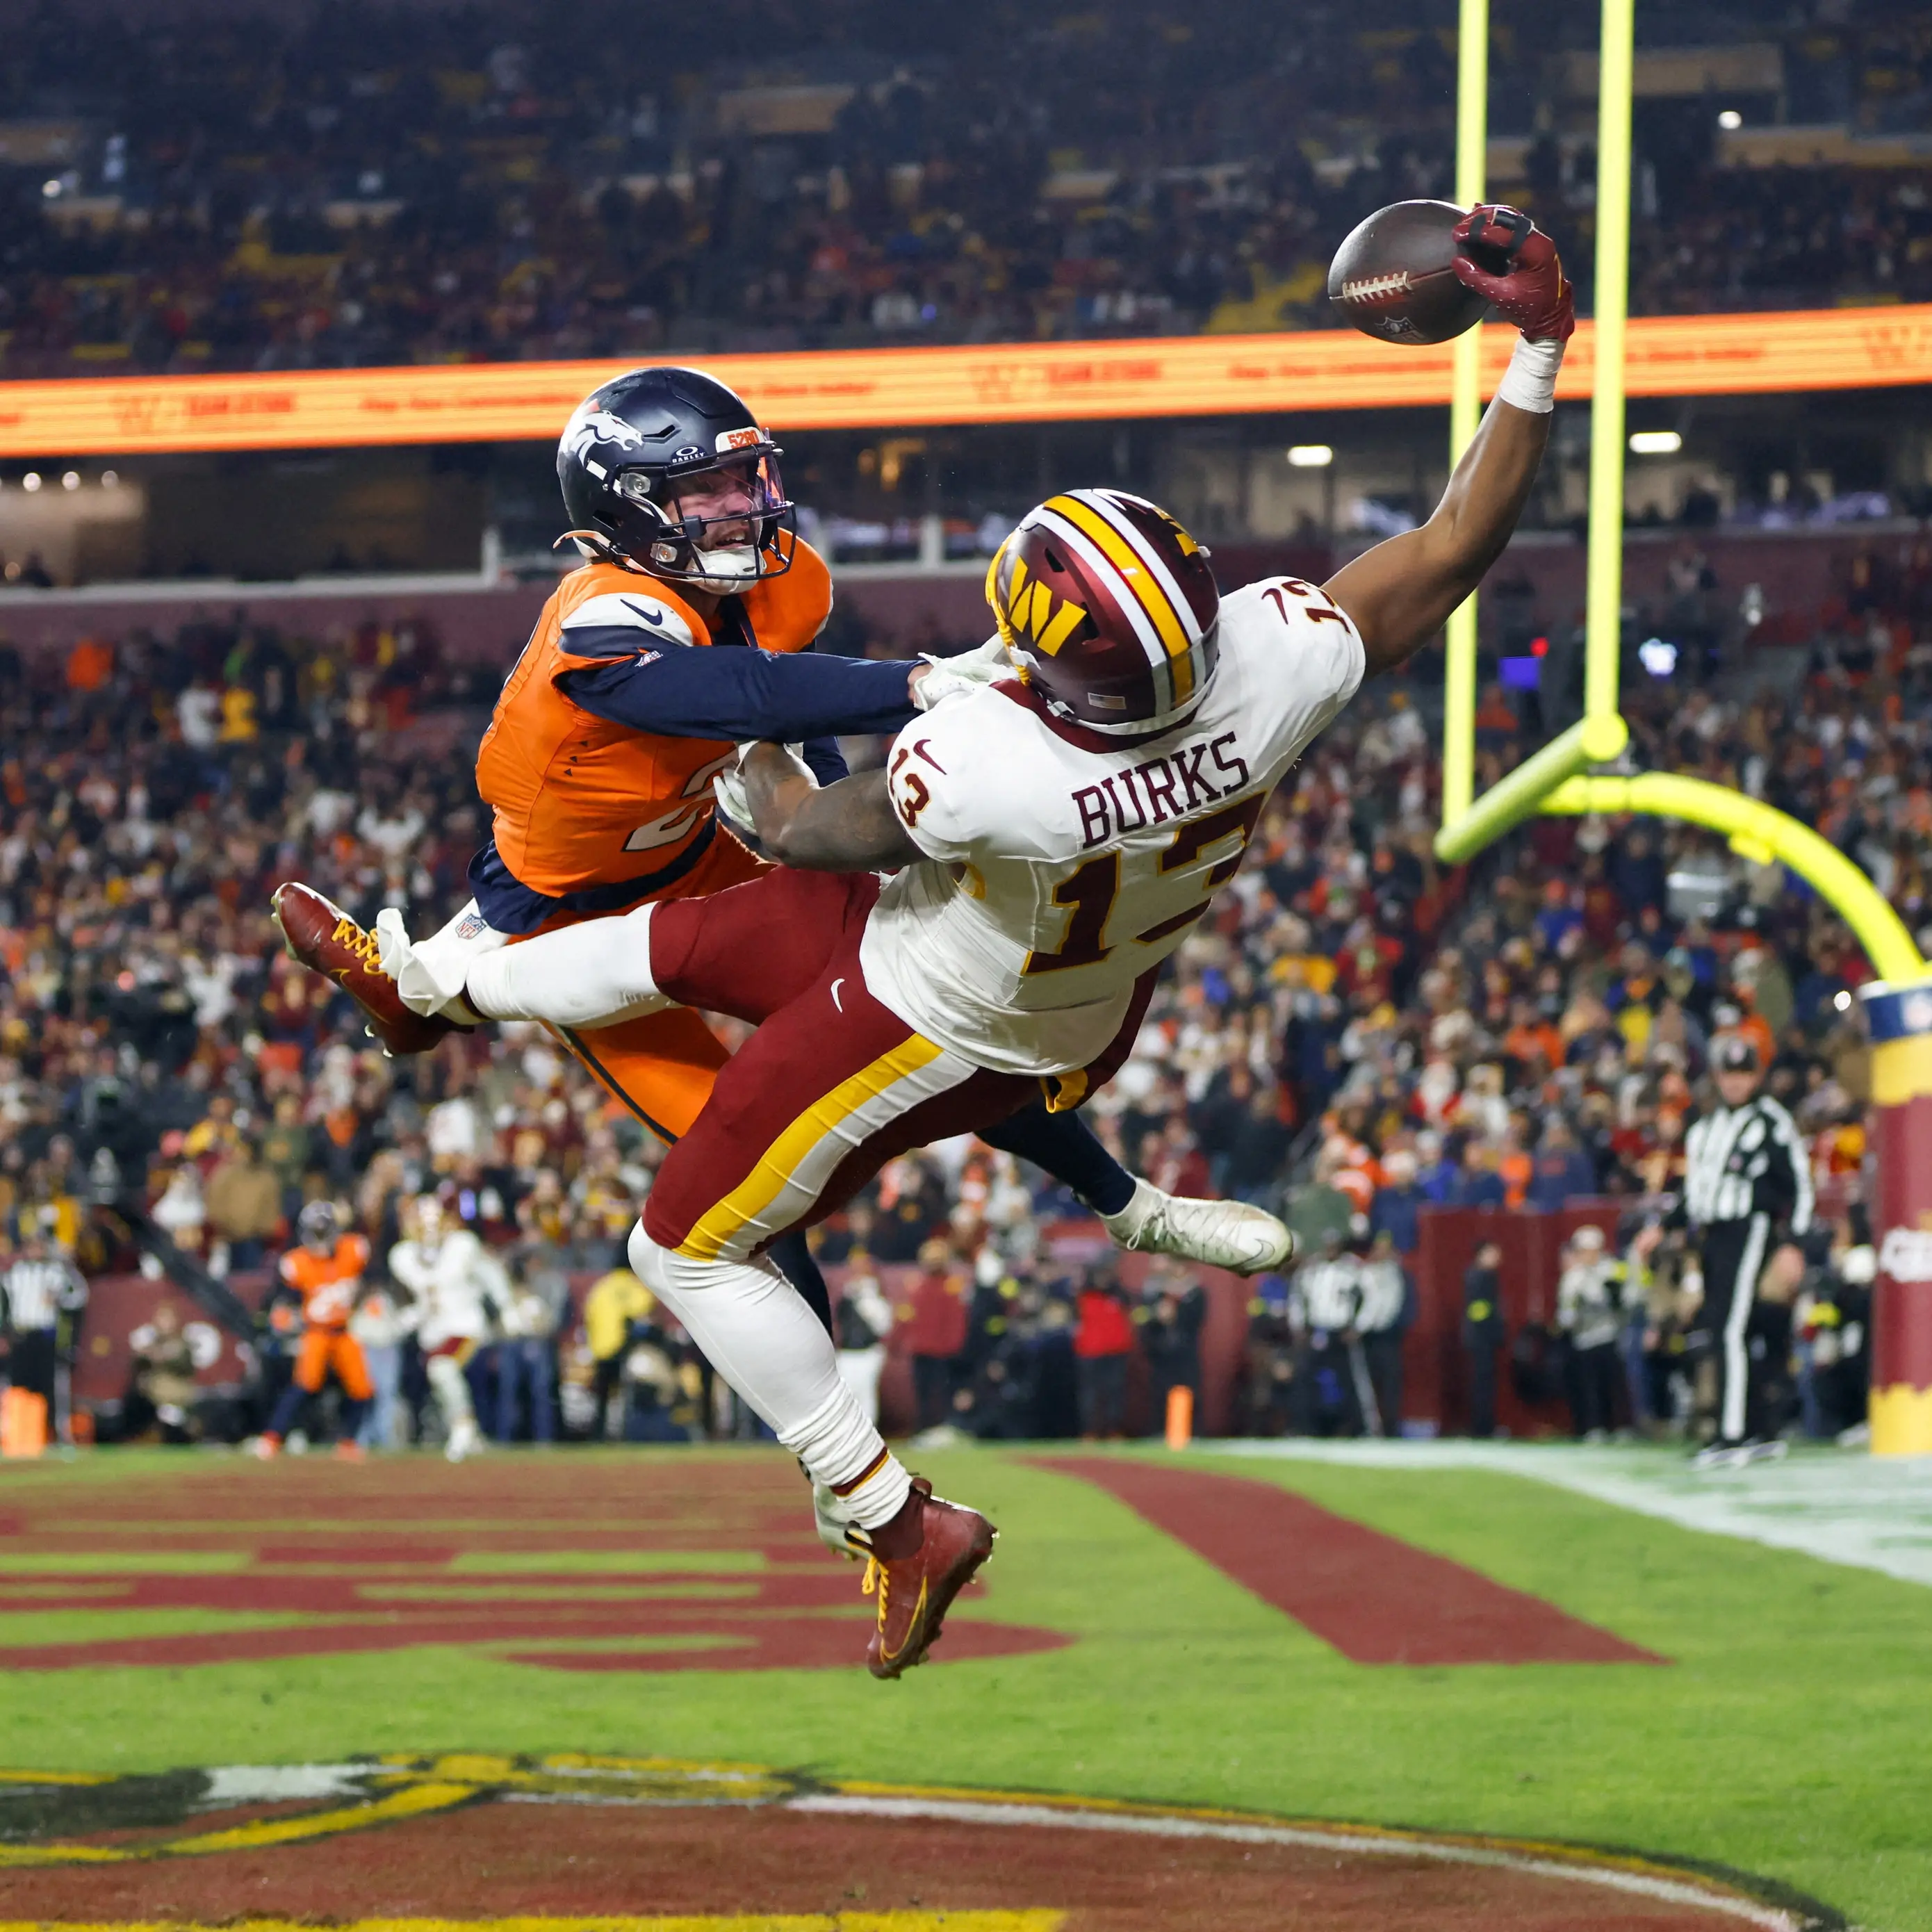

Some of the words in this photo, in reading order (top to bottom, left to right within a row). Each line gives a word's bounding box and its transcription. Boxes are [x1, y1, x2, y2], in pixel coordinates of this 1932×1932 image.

[727, 429, 760, 449] 5280
[672, 452, 705, 464] OAKLEY
[889, 748, 931, 829] 13
[1072, 731, 1250, 849] BURKS
[457, 922, 476, 938] NFL
